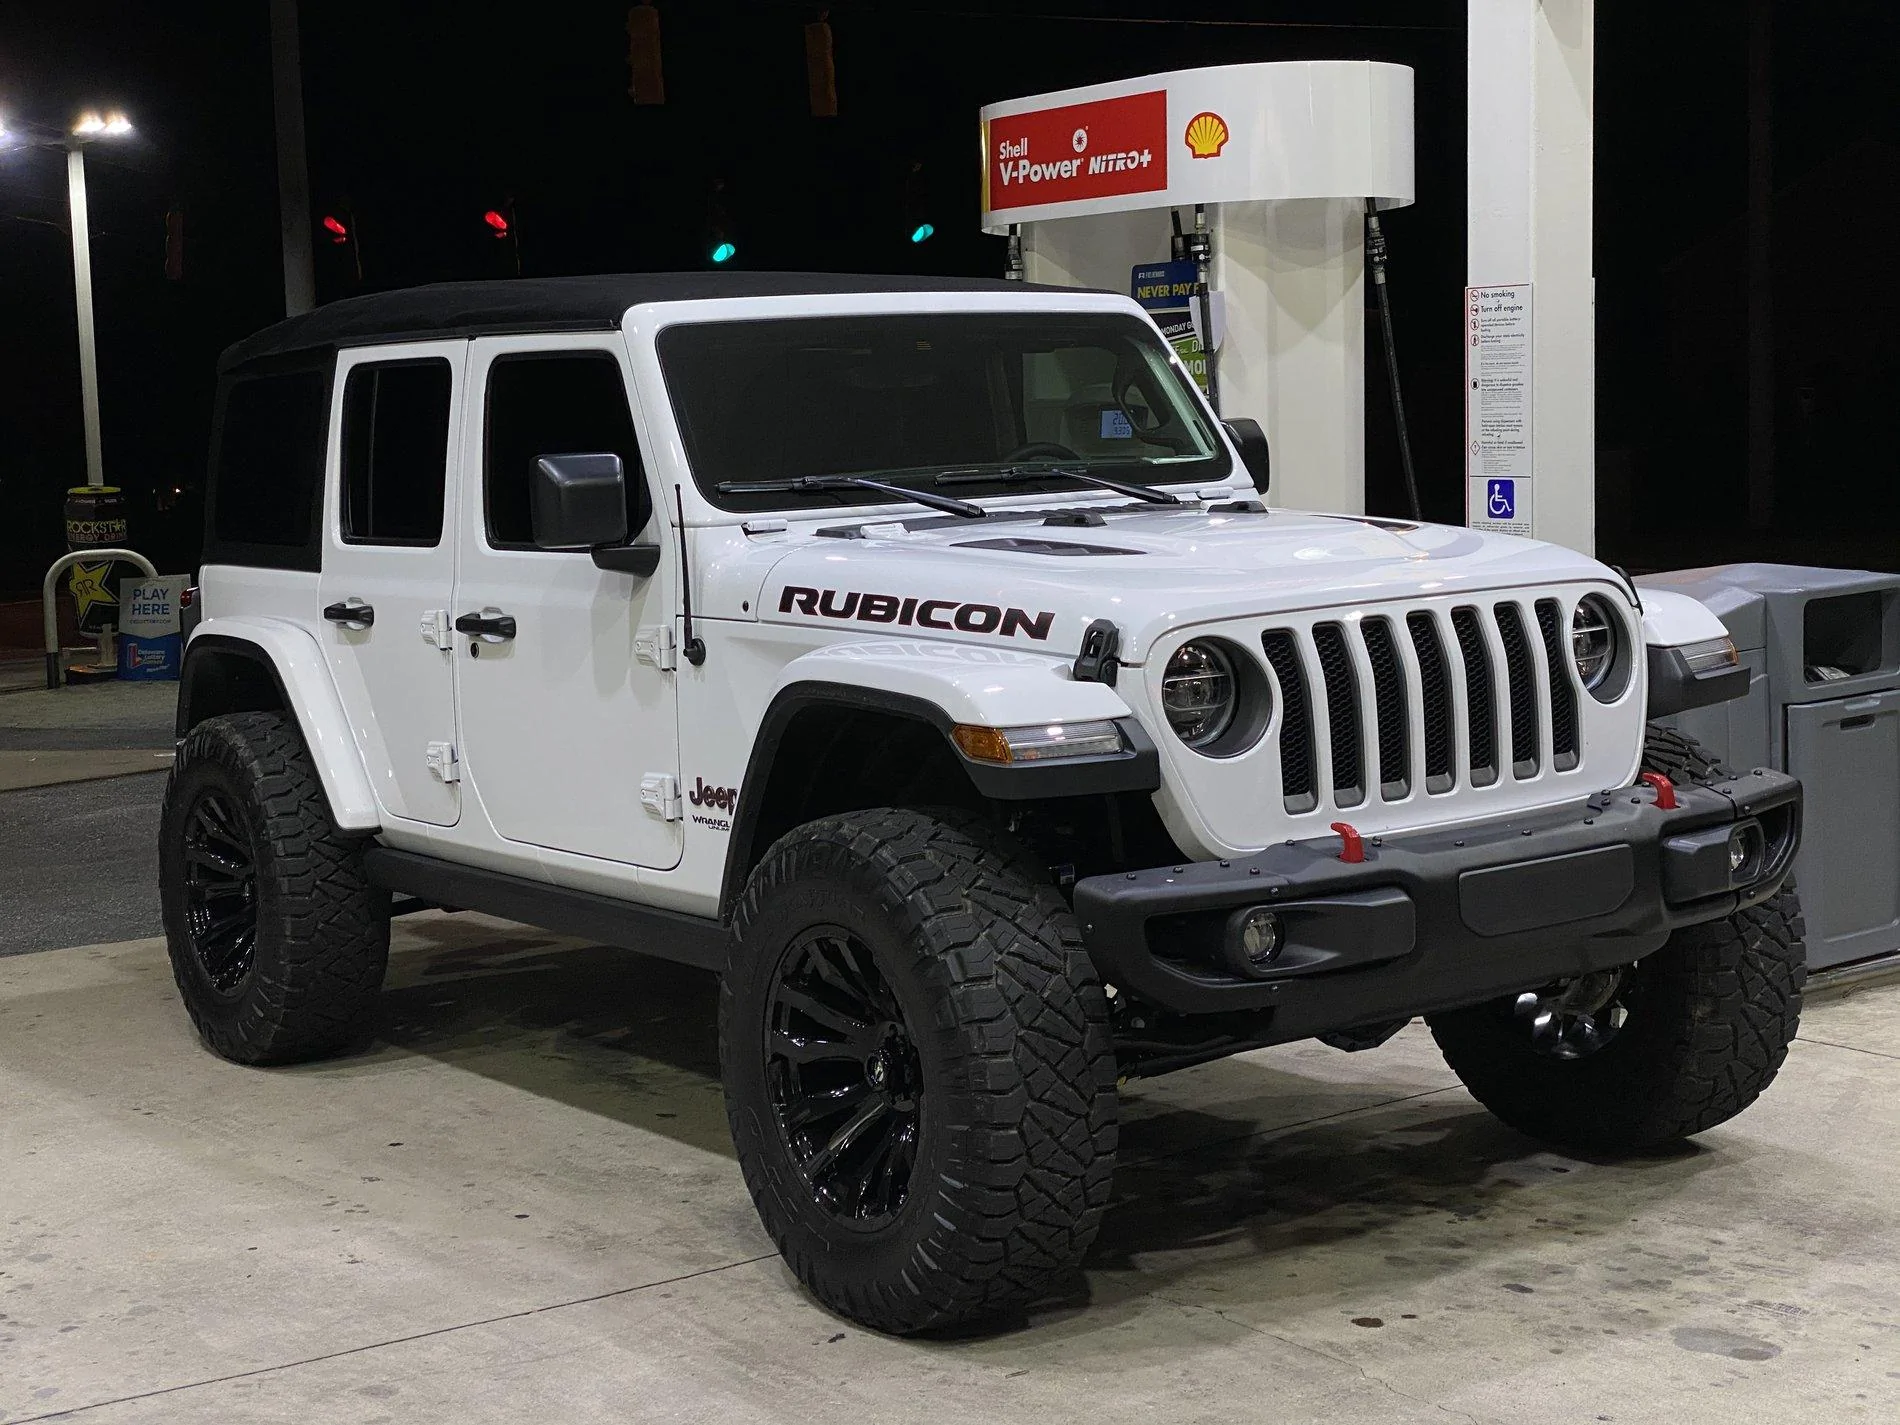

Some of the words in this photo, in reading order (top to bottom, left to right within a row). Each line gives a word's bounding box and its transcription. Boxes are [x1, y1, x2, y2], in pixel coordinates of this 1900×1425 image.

[999, 137, 1028, 160] Shell
[1000, 158, 1081, 186] V-Power
[1137, 284, 1170, 299] NEVER
[1172, 282, 1191, 296] PAY
[1480, 291, 1490, 299] No
[1490, 289, 1515, 299] smoking
[1481, 305, 1493, 313] Turn
[1493, 303, 1503, 312] off
[1503, 303, 1524, 313] engine
[133, 588, 169, 601] PLAY
[132, 603, 170, 615] HERE
[777, 585, 1056, 641] RUBICON
[692, 814, 731, 828] WRANGL
